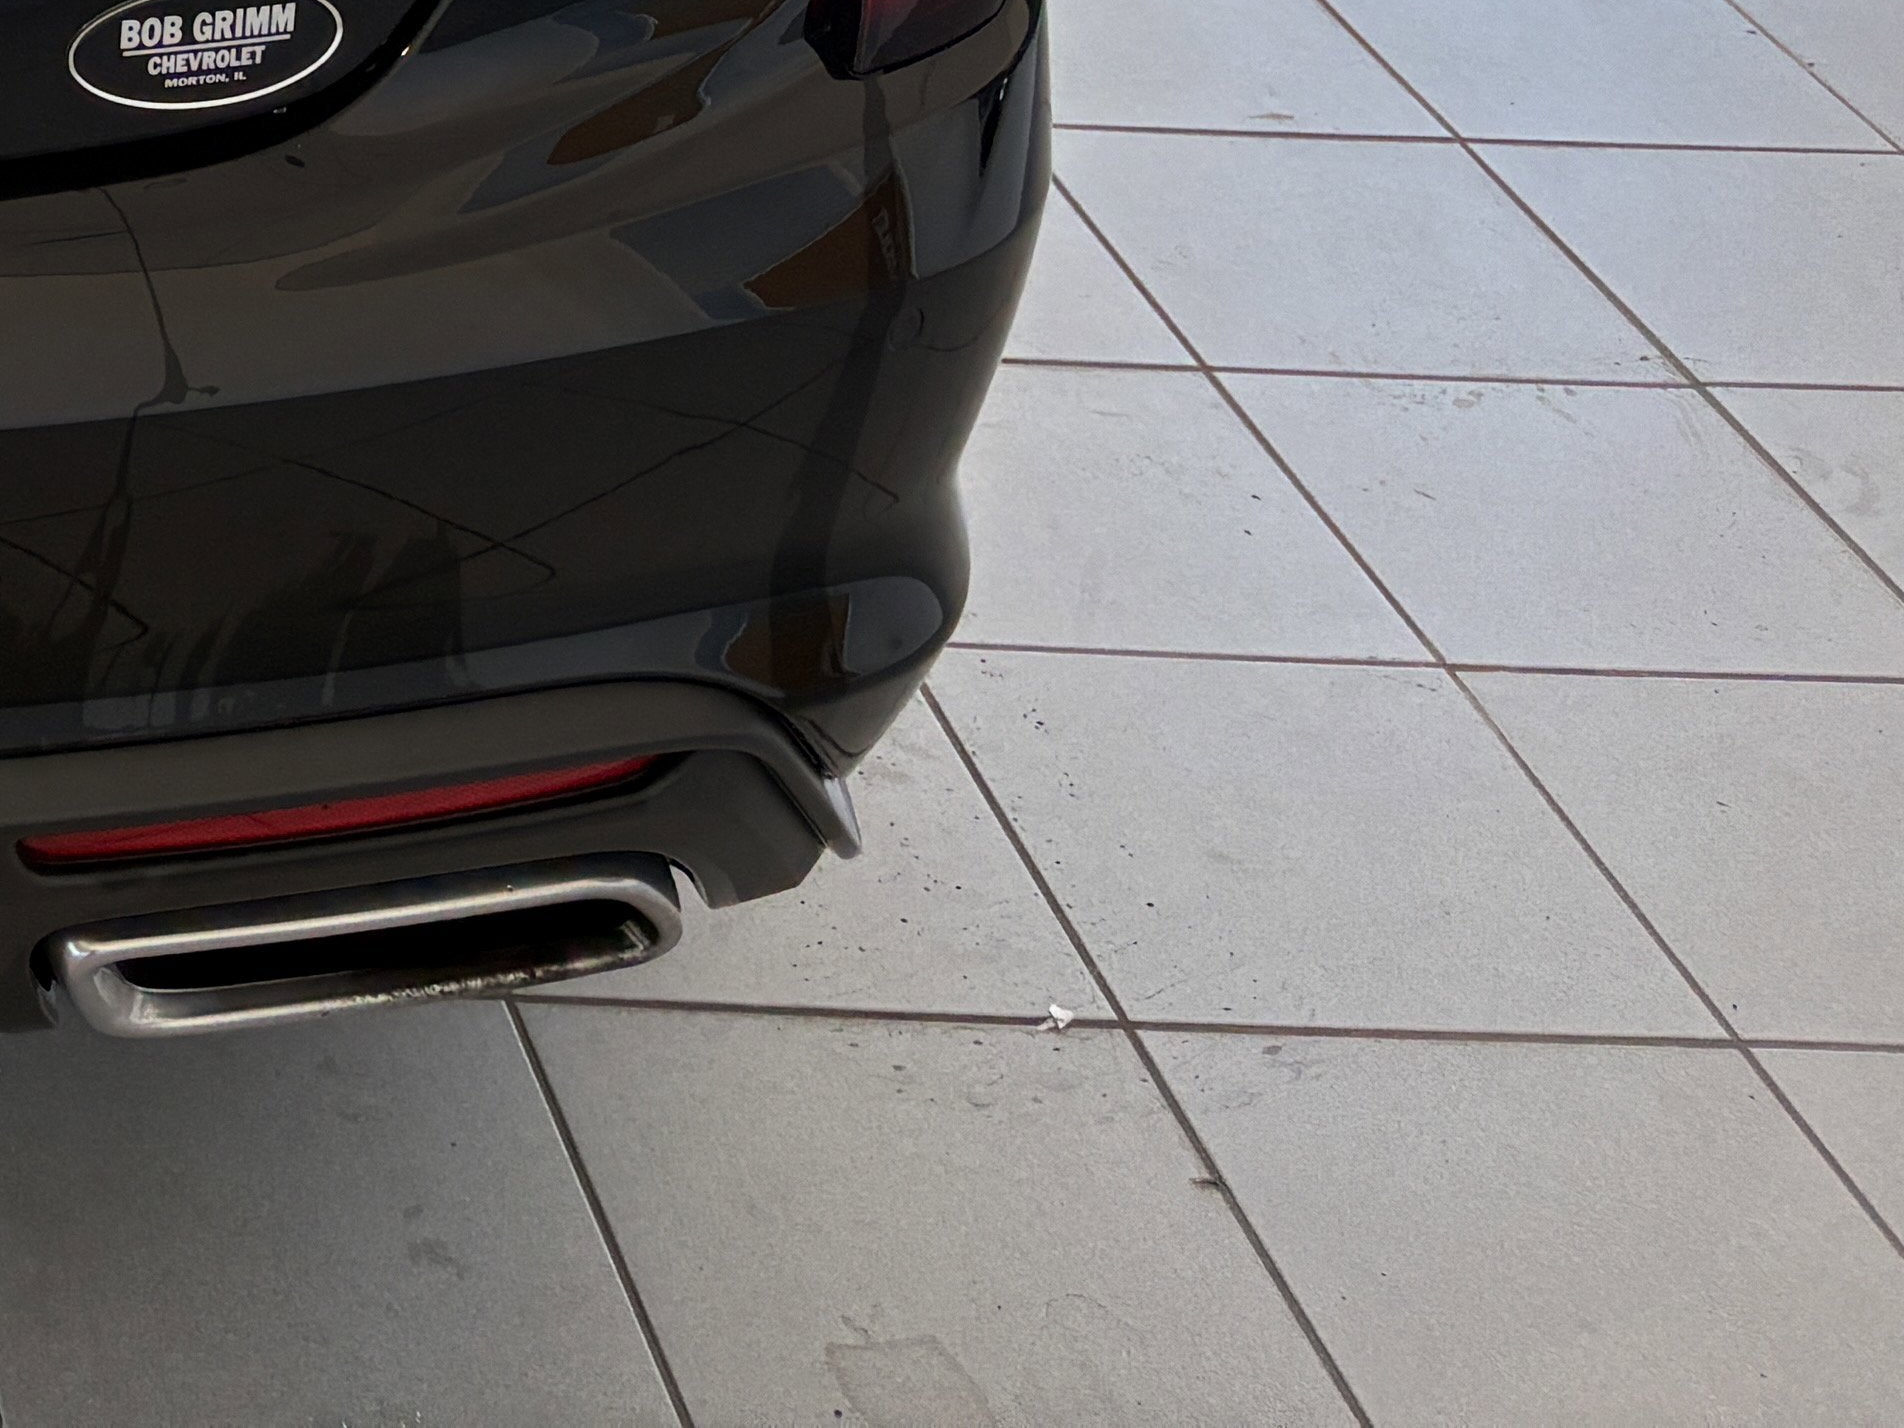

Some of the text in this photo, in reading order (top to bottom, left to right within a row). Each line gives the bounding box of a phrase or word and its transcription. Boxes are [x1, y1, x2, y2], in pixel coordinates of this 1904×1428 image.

[119, 2, 297, 50] BOB GRIMM
[147, 45, 267, 76] CHEVROLET
[164, 73, 230, 89] MORTON,
